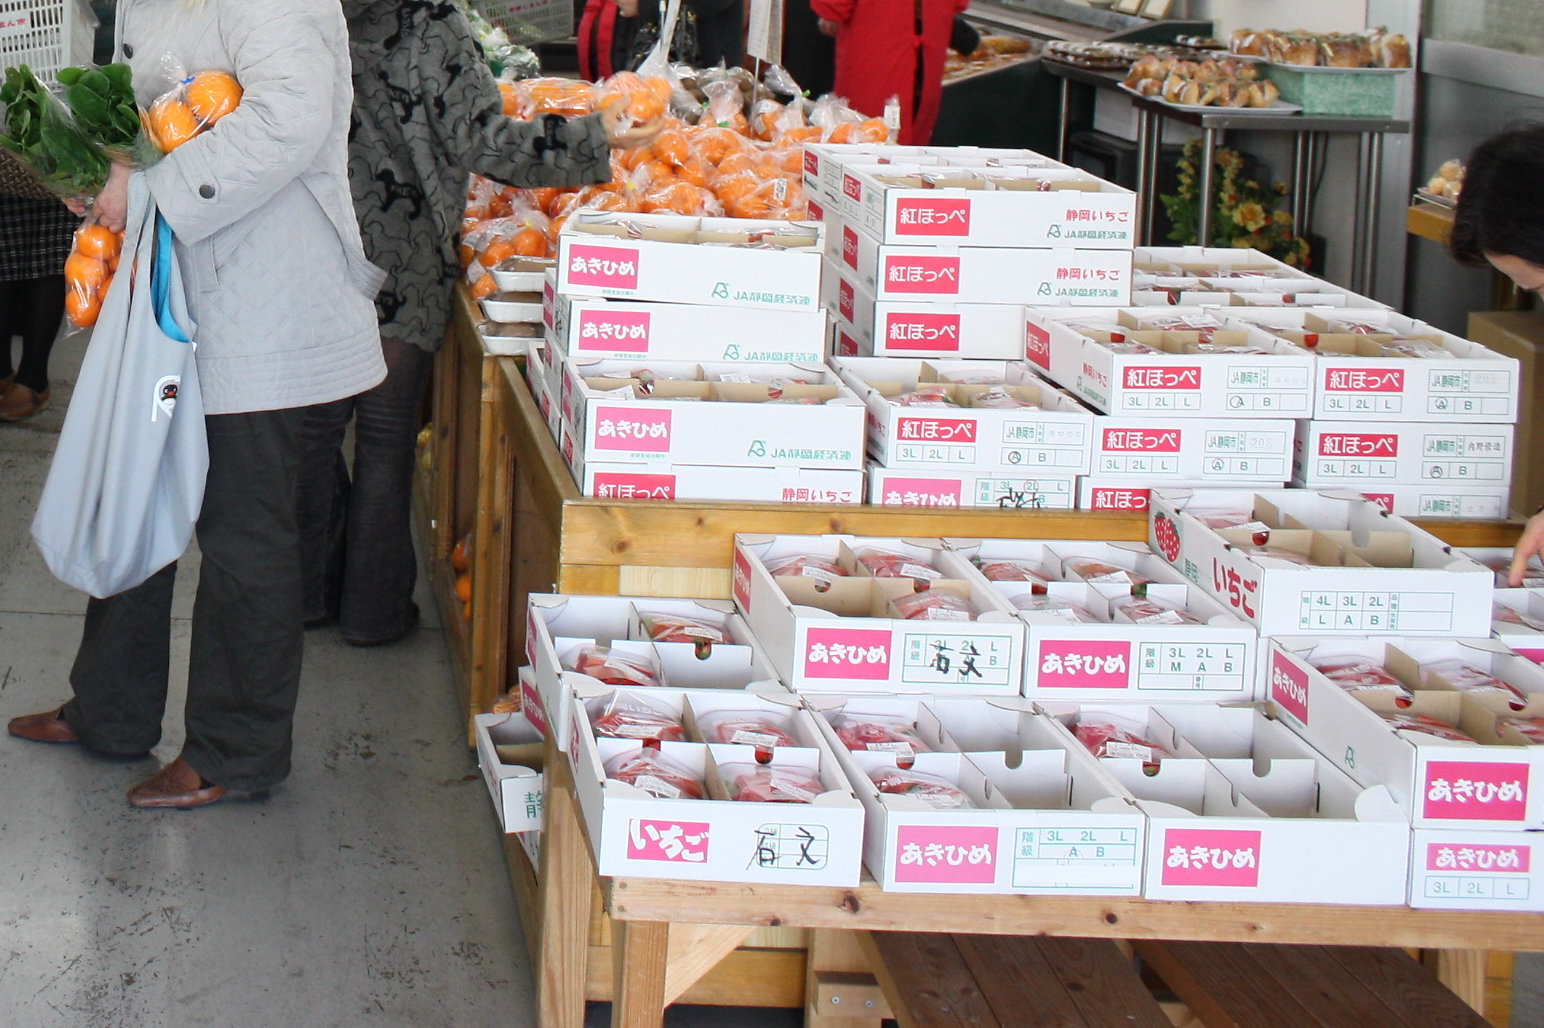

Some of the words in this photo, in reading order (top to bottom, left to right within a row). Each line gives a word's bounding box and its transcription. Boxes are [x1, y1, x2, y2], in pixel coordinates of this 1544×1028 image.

[900, 208, 966, 225] 紅ほっぺ
[1066, 209, 1129, 222] 静岡いちご
[571, 257, 635, 276] あきひめ
[889, 266, 955, 282] 紅ほっぺ
[1056, 267, 1120, 281] 静岡いちご
[582, 322, 646, 339] あきひめ
[890, 323, 956, 340] 紅ほっぺ
[1127, 369, 1197, 387] 紅ほっぺ
[1330, 371, 1400, 388] 紅ほっぺ
[1128, 397, 1142, 406] 3L
[1155, 397, 1169, 407] 2L
[1184, 397, 1190, 406] L
[1263, 397, 1271, 406] B
[1330, 399, 1343, 408] 3L
[1356, 399, 1369, 409] 2L
[1385, 400, 1391, 409] L
[1464, 401, 1472, 410] B
[597, 419, 667, 439] あきひめ
[902, 420, 973, 439] 紅ほっぺ
[1107, 431, 1177, 449] 紅ほっぺ
[1323, 437, 1393, 453] 紅ほっぺ
[902, 448, 915, 458] 3L
[929, 449, 943, 459] 2L
[958, 451, 965, 459] L
[1038, 453, 1046, 462] B
[1106, 460, 1119, 469] 3L
[1133, 460, 1146, 470] 2L
[1161, 461, 1168, 470] L
[1240, 461, 1248, 470] B
[1323, 464, 1337, 474] 3L
[1350, 464, 1364, 474] 2L
[1379, 465, 1385, 474] L
[1459, 466, 1467, 475] B
[598, 483, 670, 499] 紅ほっぺ
[1026, 482, 1039, 490] 2L
[1057, 483, 1063, 491] L
[782, 488, 852, 503] 静岡いちご
[1096, 491, 1150, 508] 紅ほっ
[1213, 557, 1257, 618] いちご
[1317, 596, 1331, 606] 4L
[1343, 596, 1357, 607] 3L
[1369, 596, 1384, 607] 2L
[1319, 615, 1325, 625] L
[1344, 615, 1353, 625] A
[1371, 615, 1378, 625] B
[809, 643, 887, 664] あきひめ
[990, 642, 998, 652] L
[1169, 648, 1186, 658] 3L
[1196, 648, 1213, 658] 2L
[1225, 648, 1233, 658] L
[989, 656, 997, 666] B
[1042, 652, 1125, 674] あきひめ
[1170, 662, 1181, 672] M
[1197, 662, 1206, 672] A
[1224, 662, 1233, 673] B
[1273, 666, 1307, 706] あきひめ
[1428, 778, 1523, 804] あきひめ
[629, 819, 709, 861] いちご
[1021, 831, 1034, 857] 階級
[1047, 831, 1063, 841] 3L
[1081, 831, 1096, 842] 2L
[1120, 831, 1127, 842] L
[900, 842, 991, 867] あきひめ
[1069, 846, 1078, 857] A
[1096, 847, 1104, 857] B
[1167, 845, 1255, 871] あきひめ
[1436, 847, 1518, 869] あきひめ
[1433, 882, 1450, 894] 3L
[1467, 883, 1484, 895] 2L
[1505, 883, 1514, 895] L
